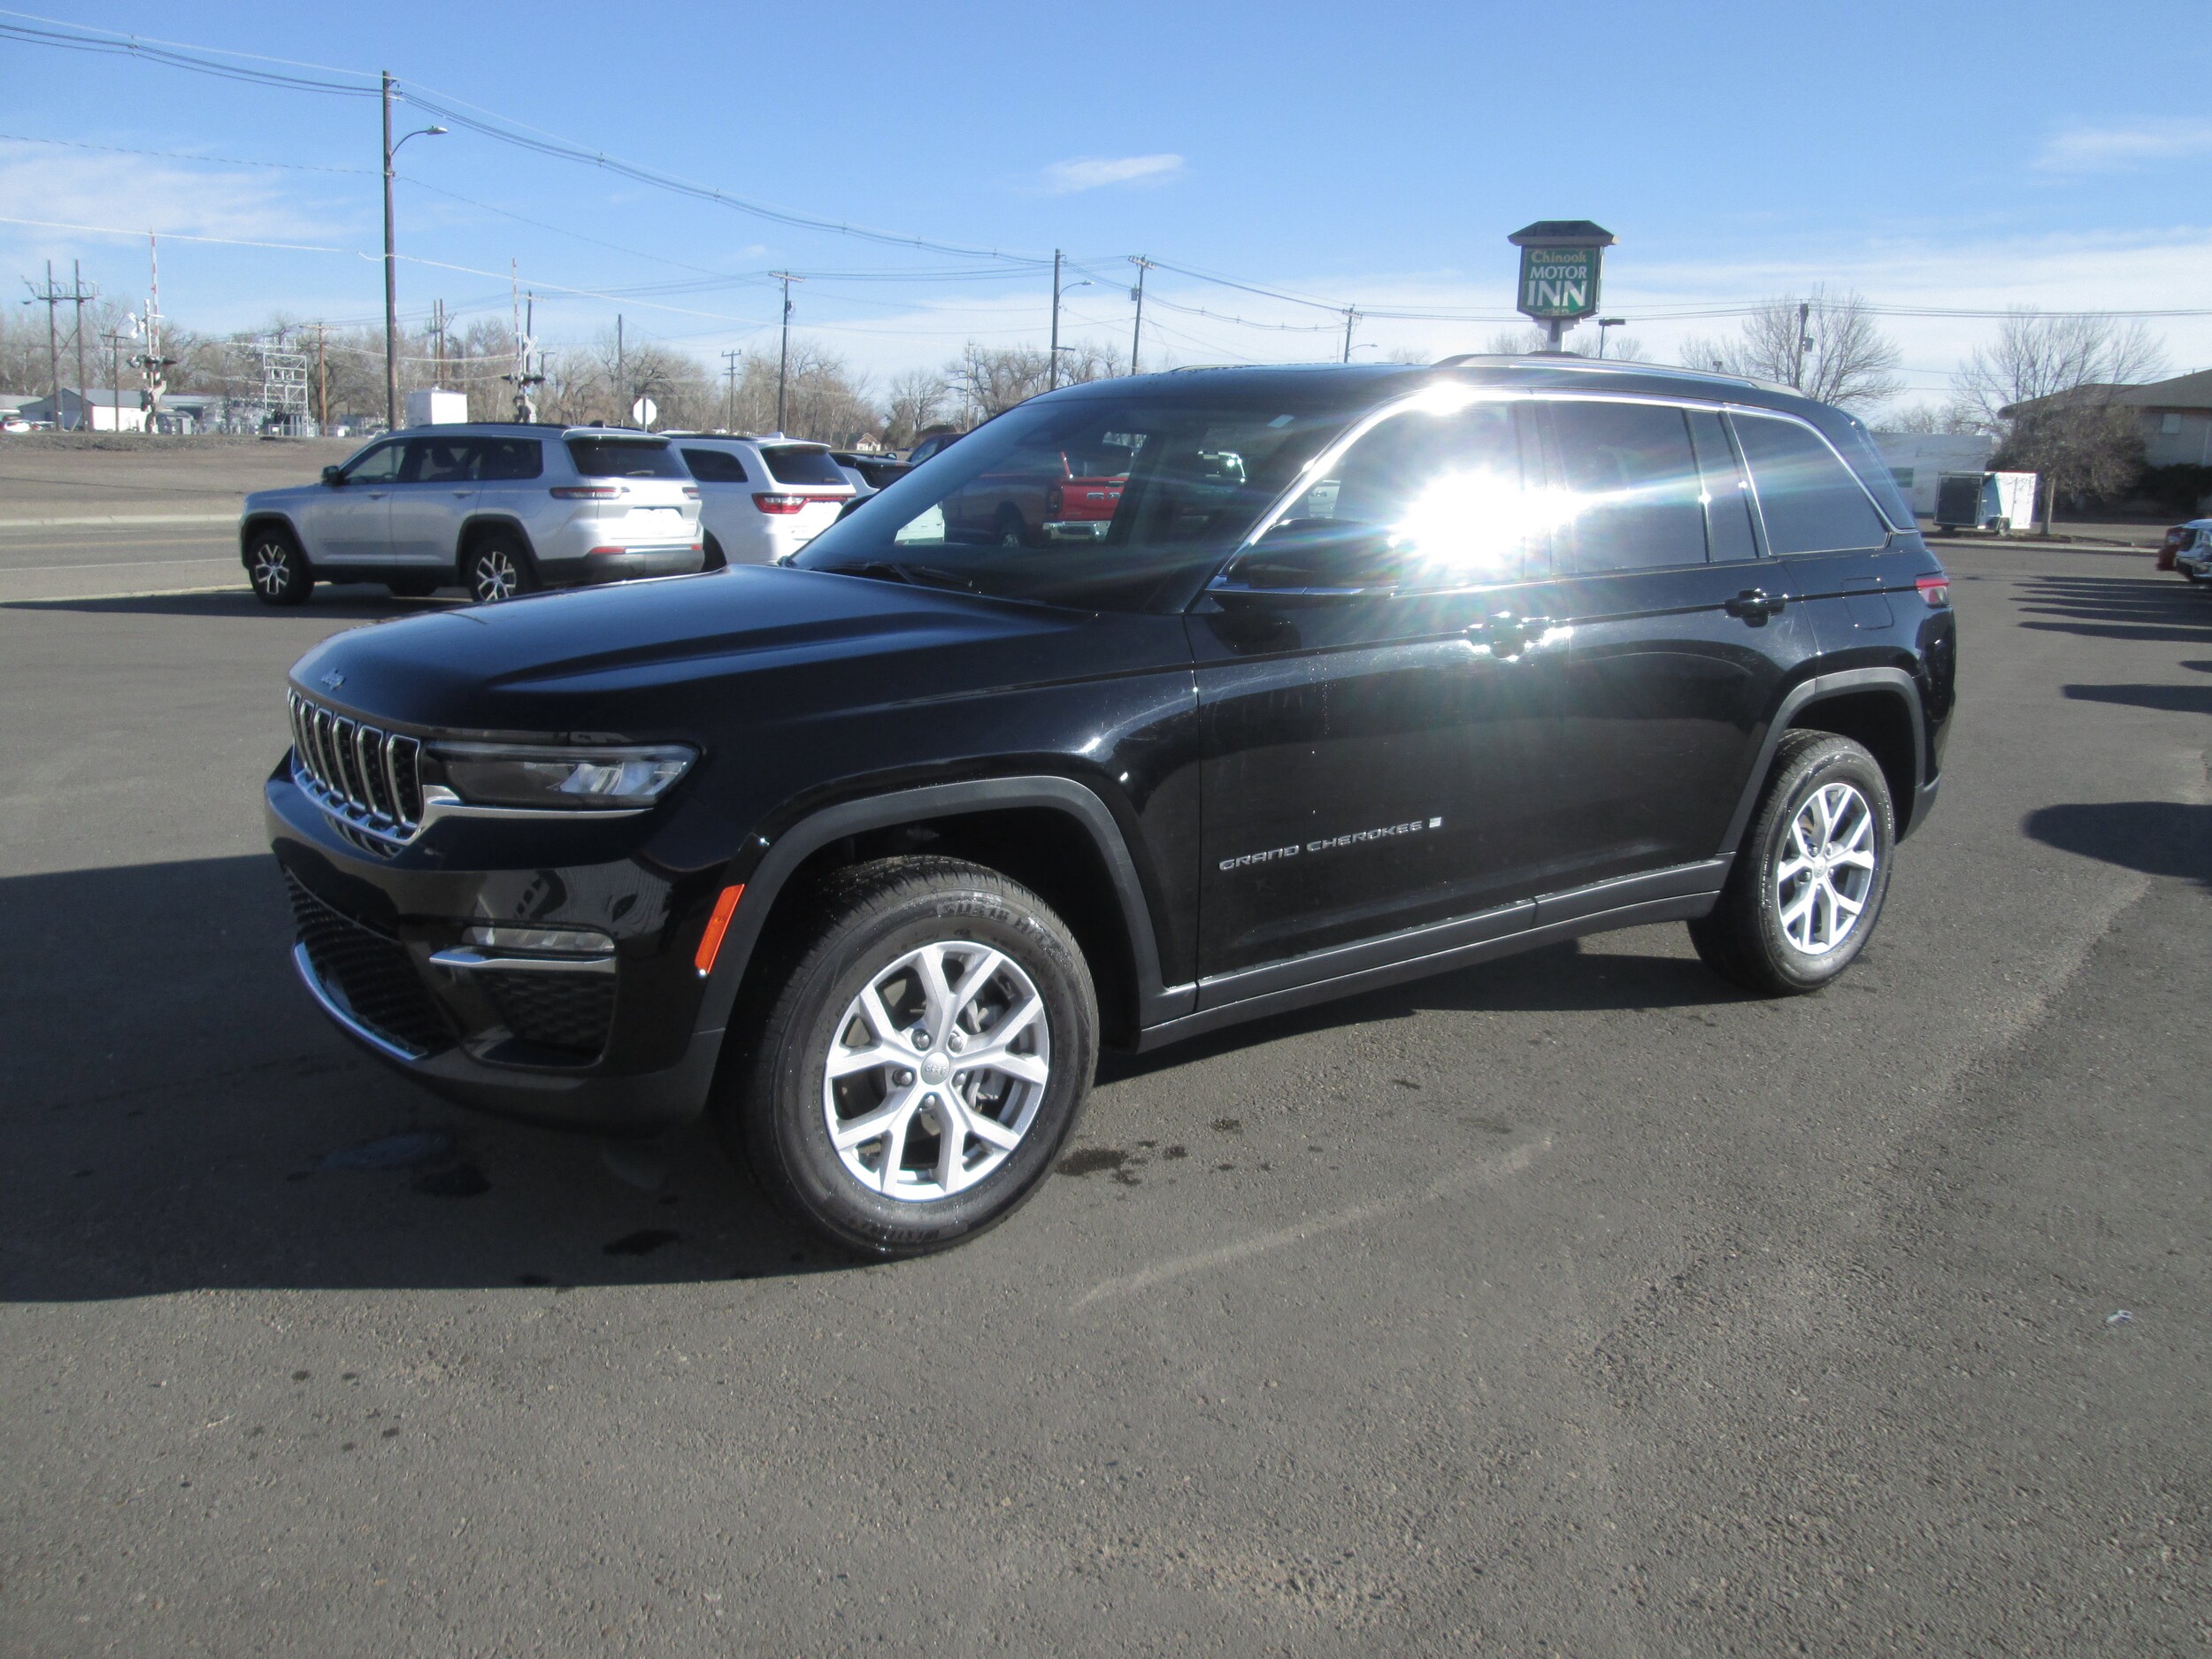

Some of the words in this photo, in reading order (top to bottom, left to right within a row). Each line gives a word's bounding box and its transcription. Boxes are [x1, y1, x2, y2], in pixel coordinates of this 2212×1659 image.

[1531, 250, 1587, 264] Chinook
[1530, 265, 1587, 280] MOTOR
[1526, 280, 1588, 307] INN
[1218, 844, 1301, 872] GRAND
[1305, 819, 1424, 853] CHEROKEE
